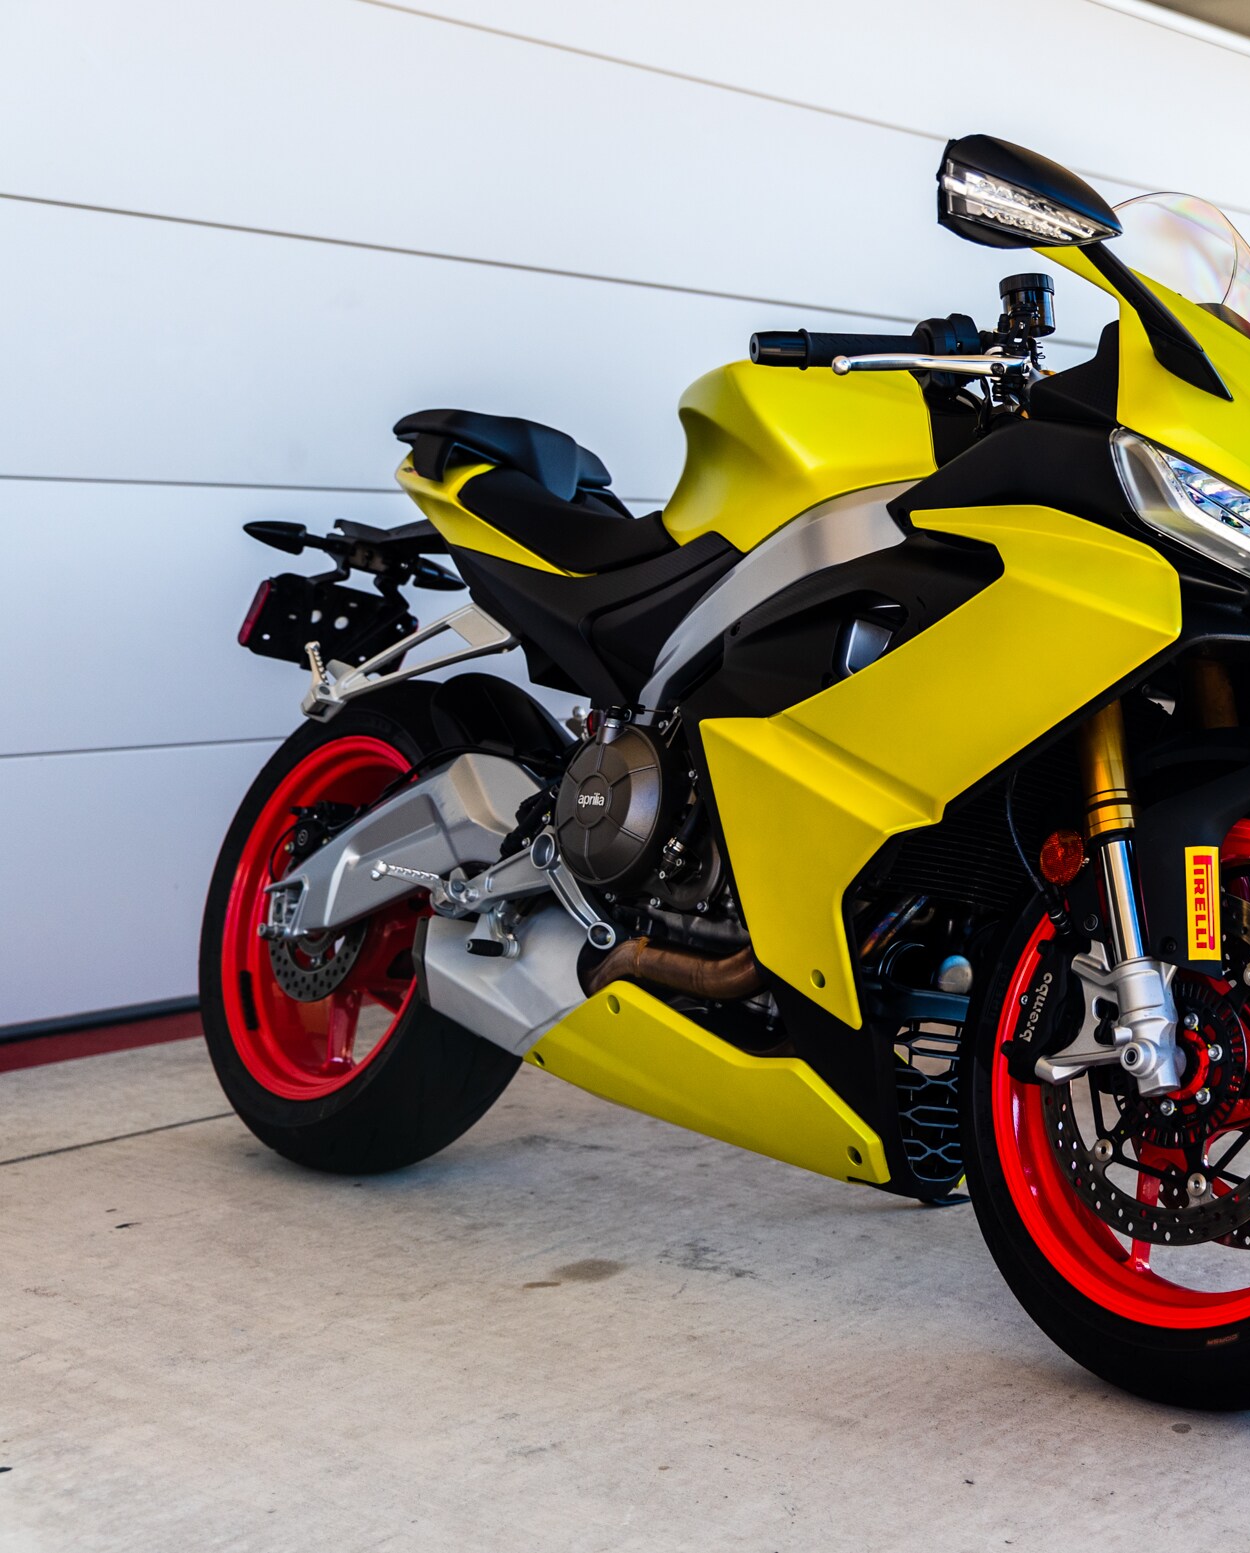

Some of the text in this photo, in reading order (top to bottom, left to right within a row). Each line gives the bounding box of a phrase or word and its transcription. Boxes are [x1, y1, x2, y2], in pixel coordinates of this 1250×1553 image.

[578, 792, 605, 808] aprilia
[1193, 855, 1215, 950] PIRELLI
[1019, 972, 1053, 1042] brembo
